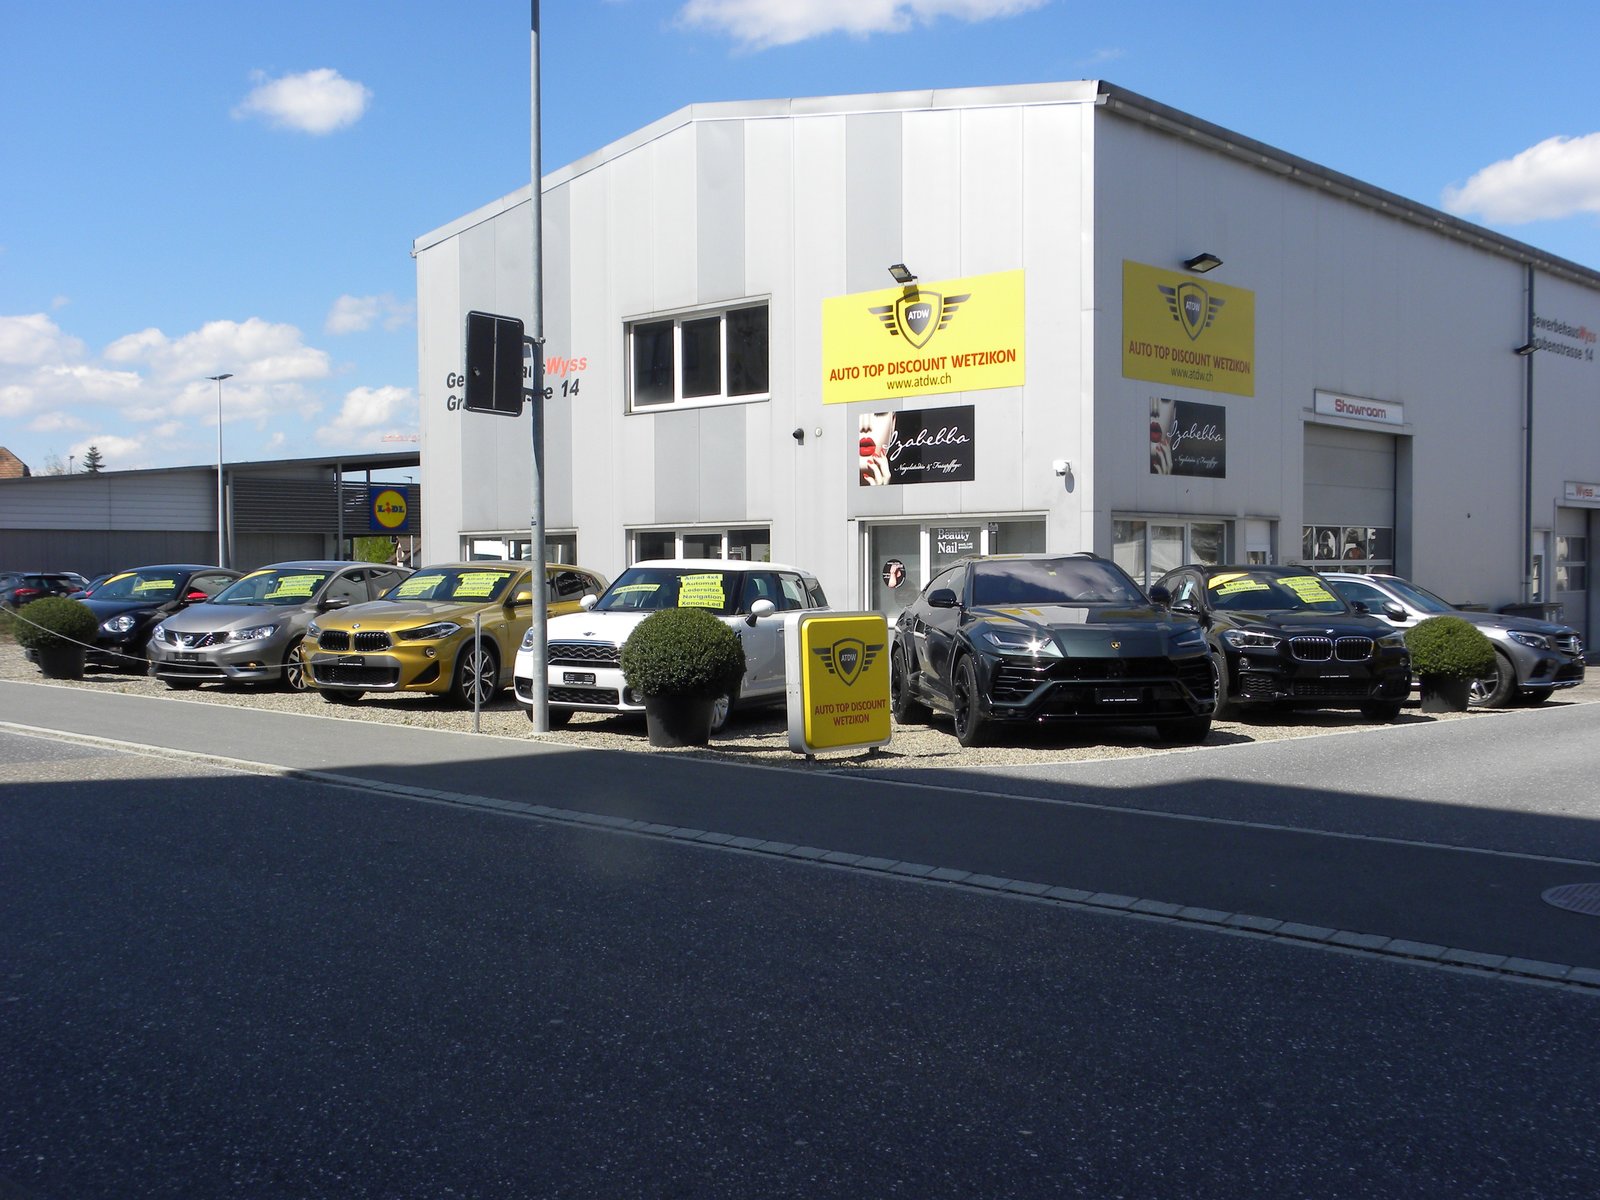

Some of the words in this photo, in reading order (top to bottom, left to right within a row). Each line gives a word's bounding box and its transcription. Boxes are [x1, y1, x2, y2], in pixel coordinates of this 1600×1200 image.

[908, 308, 930, 320] ATDW
[1128, 340, 1152, 357] AUTO
[1154, 344, 1170, 360] TOP
[1172, 349, 1211, 368] DISCOUNT
[1213, 355, 1251, 375] WETZIKON
[1585, 348, 1594, 362] 14
[830, 366, 860, 382] AUTO
[862, 363, 884, 378] TOP
[887, 356, 947, 376] DISCOUNT
[951, 348, 1016, 368] WETZIKON
[886, 372, 952, 390] www.atdw.ch
[1170, 367, 1214, 382] www.atdw.ch
[562, 378, 580, 398] 14
[1335, 399, 1386, 419] Showroom
[1576, 484, 1593, 498] Wyss
[938, 528, 970, 542] Beauty
[938, 542, 958, 554] Nail
[840, 653, 856, 662] ATDW
[814, 704, 834, 716] AUTO
[835, 702, 850, 713] TOP
[852, 699, 886, 711] DISCOUNT
[833, 714, 870, 726] WETZIKON
